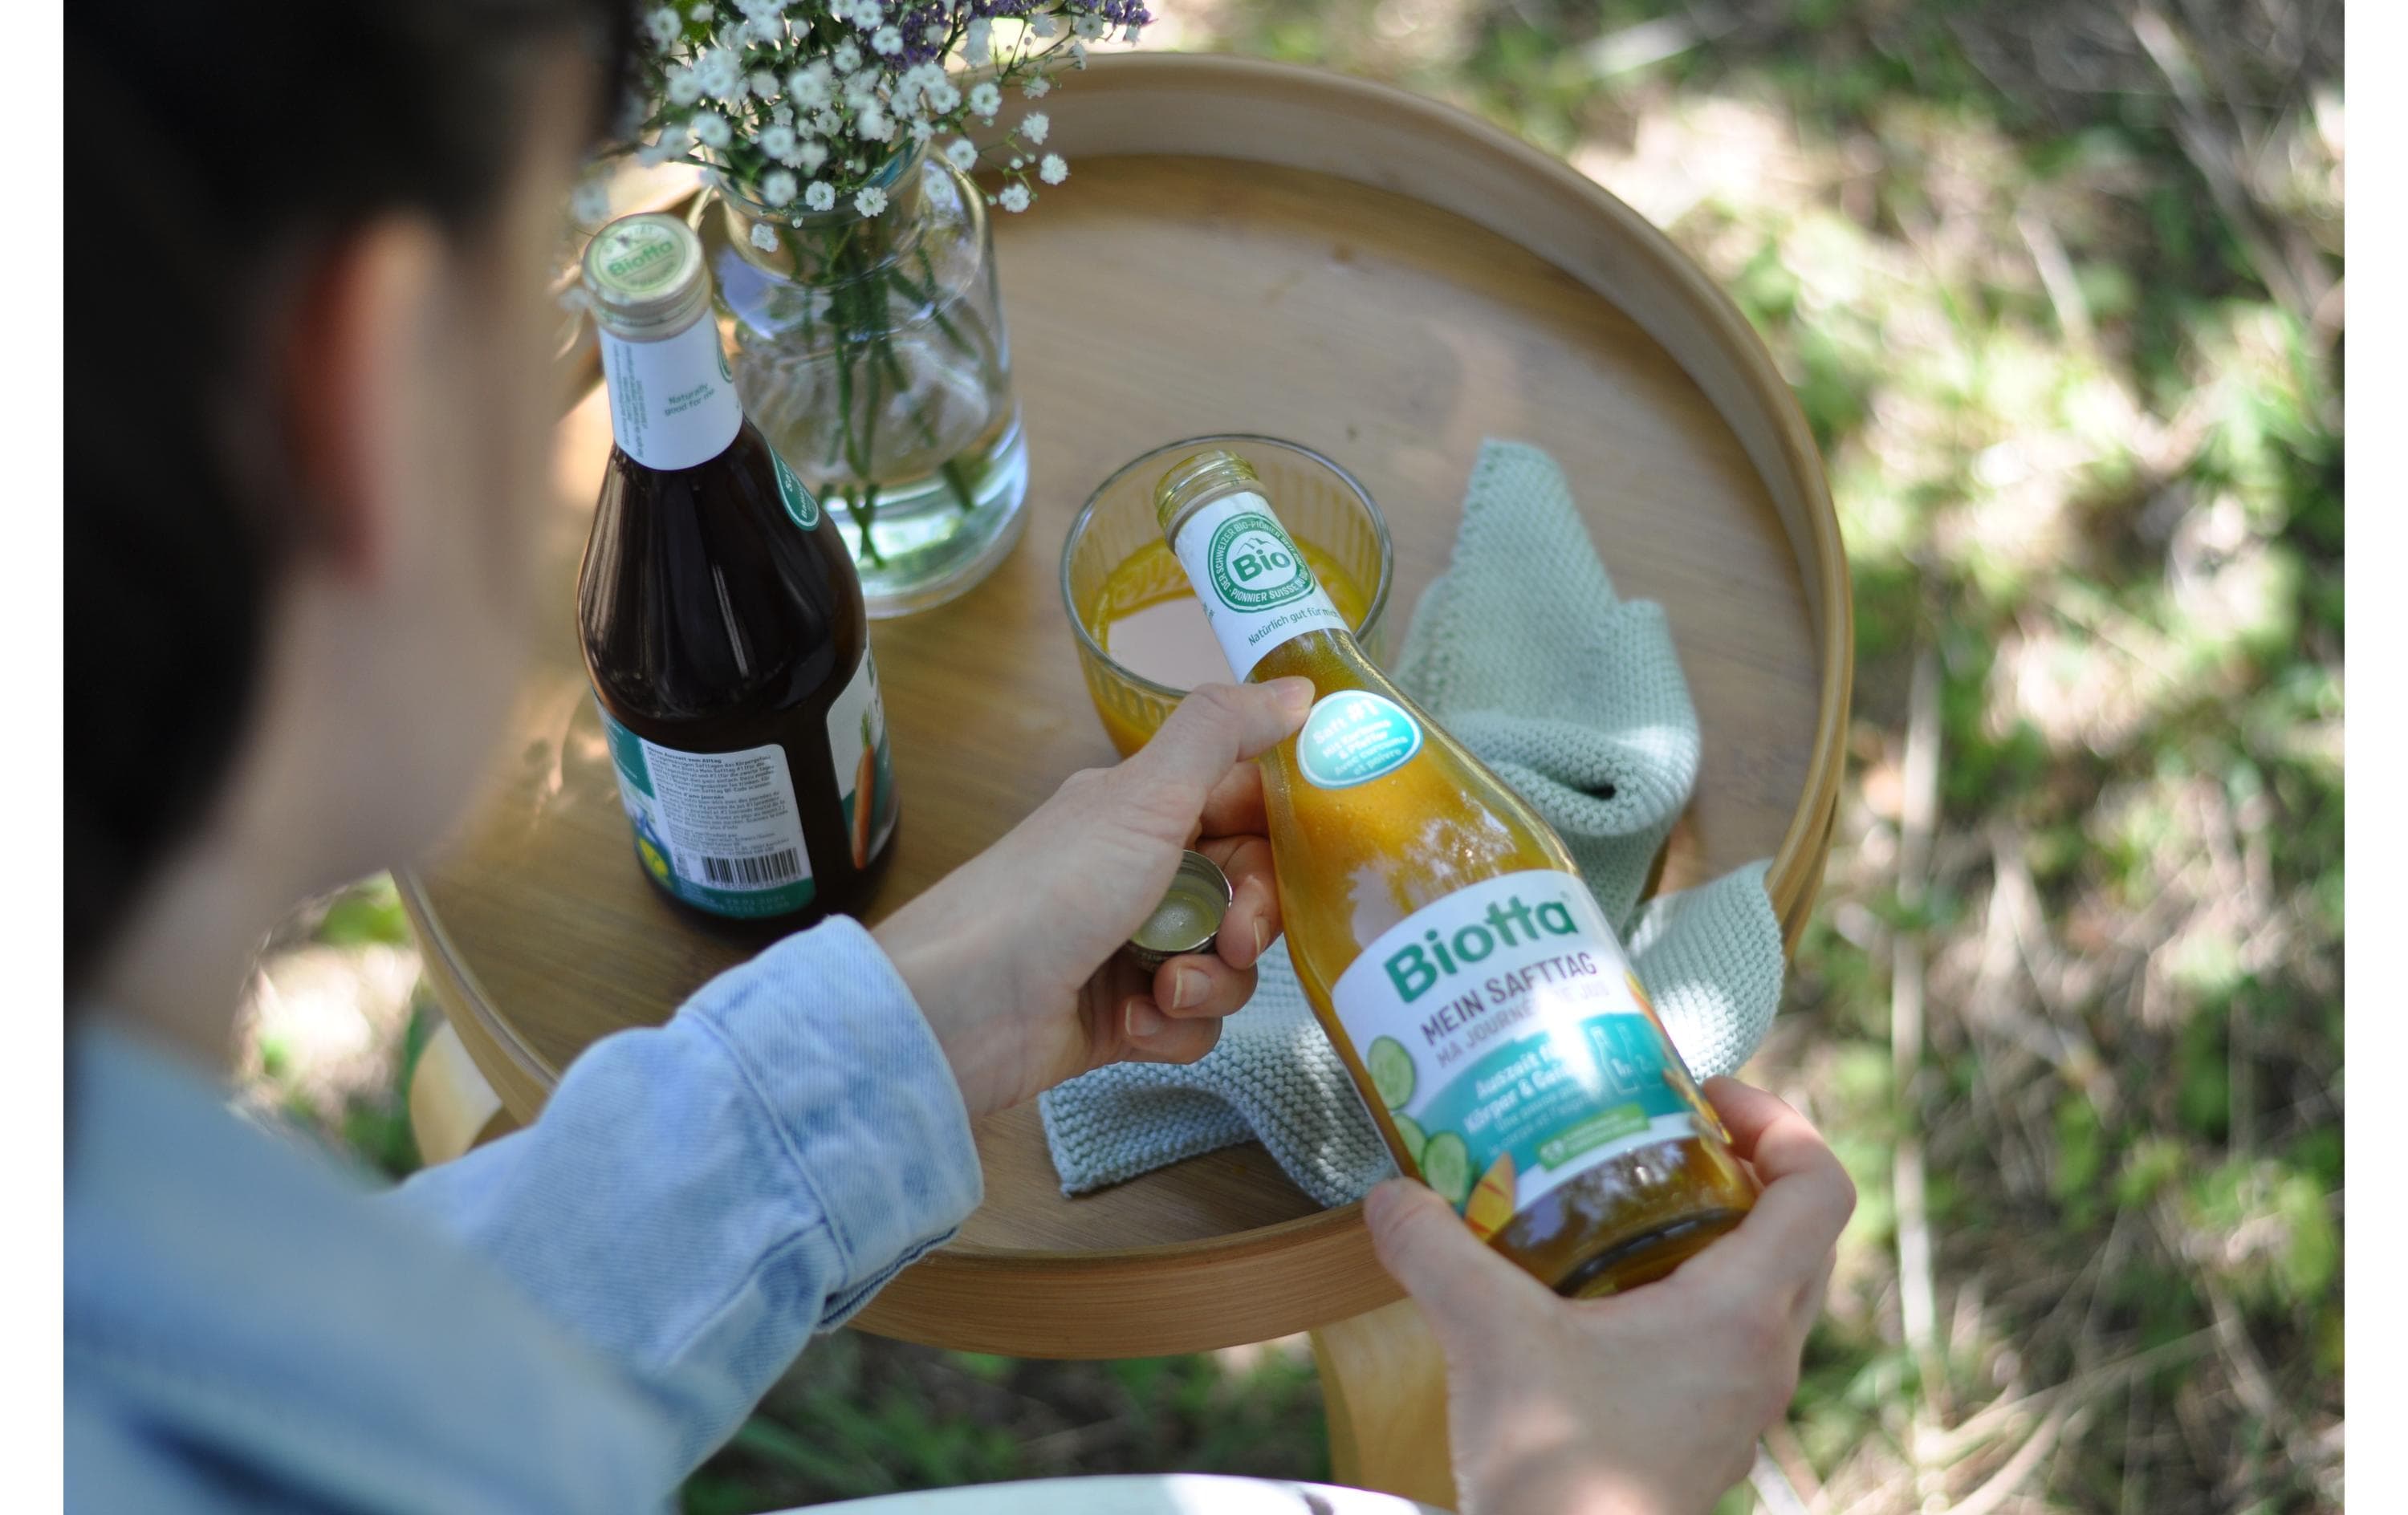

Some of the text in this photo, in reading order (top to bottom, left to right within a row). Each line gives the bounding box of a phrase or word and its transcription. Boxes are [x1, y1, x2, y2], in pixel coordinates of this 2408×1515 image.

[608, 241, 673, 277] Biotta
[665, 388, 715, 417] good for me
[669, 383, 709, 405] Naturally
[1214, 528, 1236, 574] SCHWEIZER
[1232, 549, 1291, 583] Bio
[1218, 571, 1230, 591] DER
[1230, 589, 1267, 603] PIONNIER
[1269, 584, 1299, 599] SUISSE
[1247, 615, 1289, 647] Natürlich
[1291, 610, 1308, 623] gut
[1307, 607, 1322, 618] für
[1347, 699, 1380, 721] #1
[1366, 749, 1401, 769] poivre
[1384, 895, 1579, 1004] Biotta
[1420, 952, 1597, 1046] MEIN SAFTTAG
[1437, 1040, 1462, 1068] MA
[1466, 999, 1536, 1048] JOURNÉ
